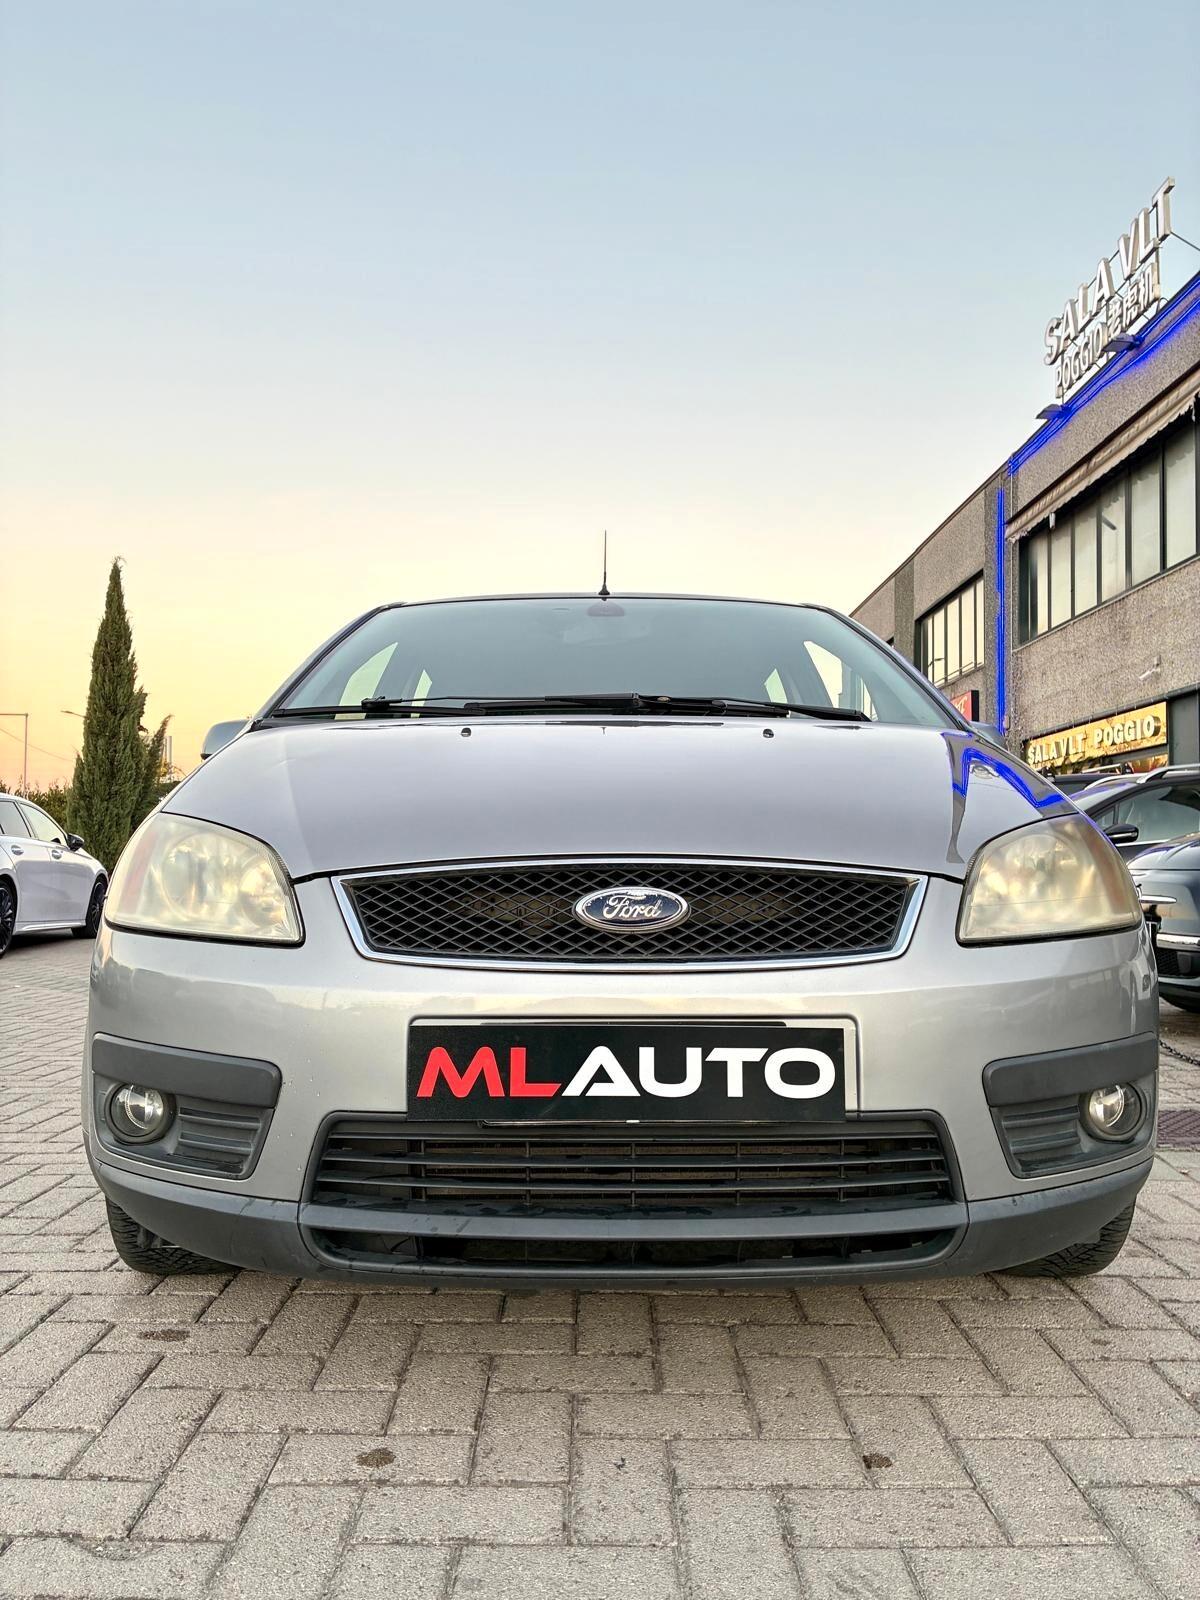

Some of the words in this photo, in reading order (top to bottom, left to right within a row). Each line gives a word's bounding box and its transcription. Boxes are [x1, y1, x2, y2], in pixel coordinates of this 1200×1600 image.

[1044, 257, 1115, 366] SALA
[1117, 176, 1175, 280] VLT
[1055, 321, 1108, 399] POGGIO
[1027, 742, 1060, 765] SALA
[1060, 734, 1086, 757] VLT
[1094, 715, 1155, 746] POGGIO
[602, 894, 662, 919] Ford
